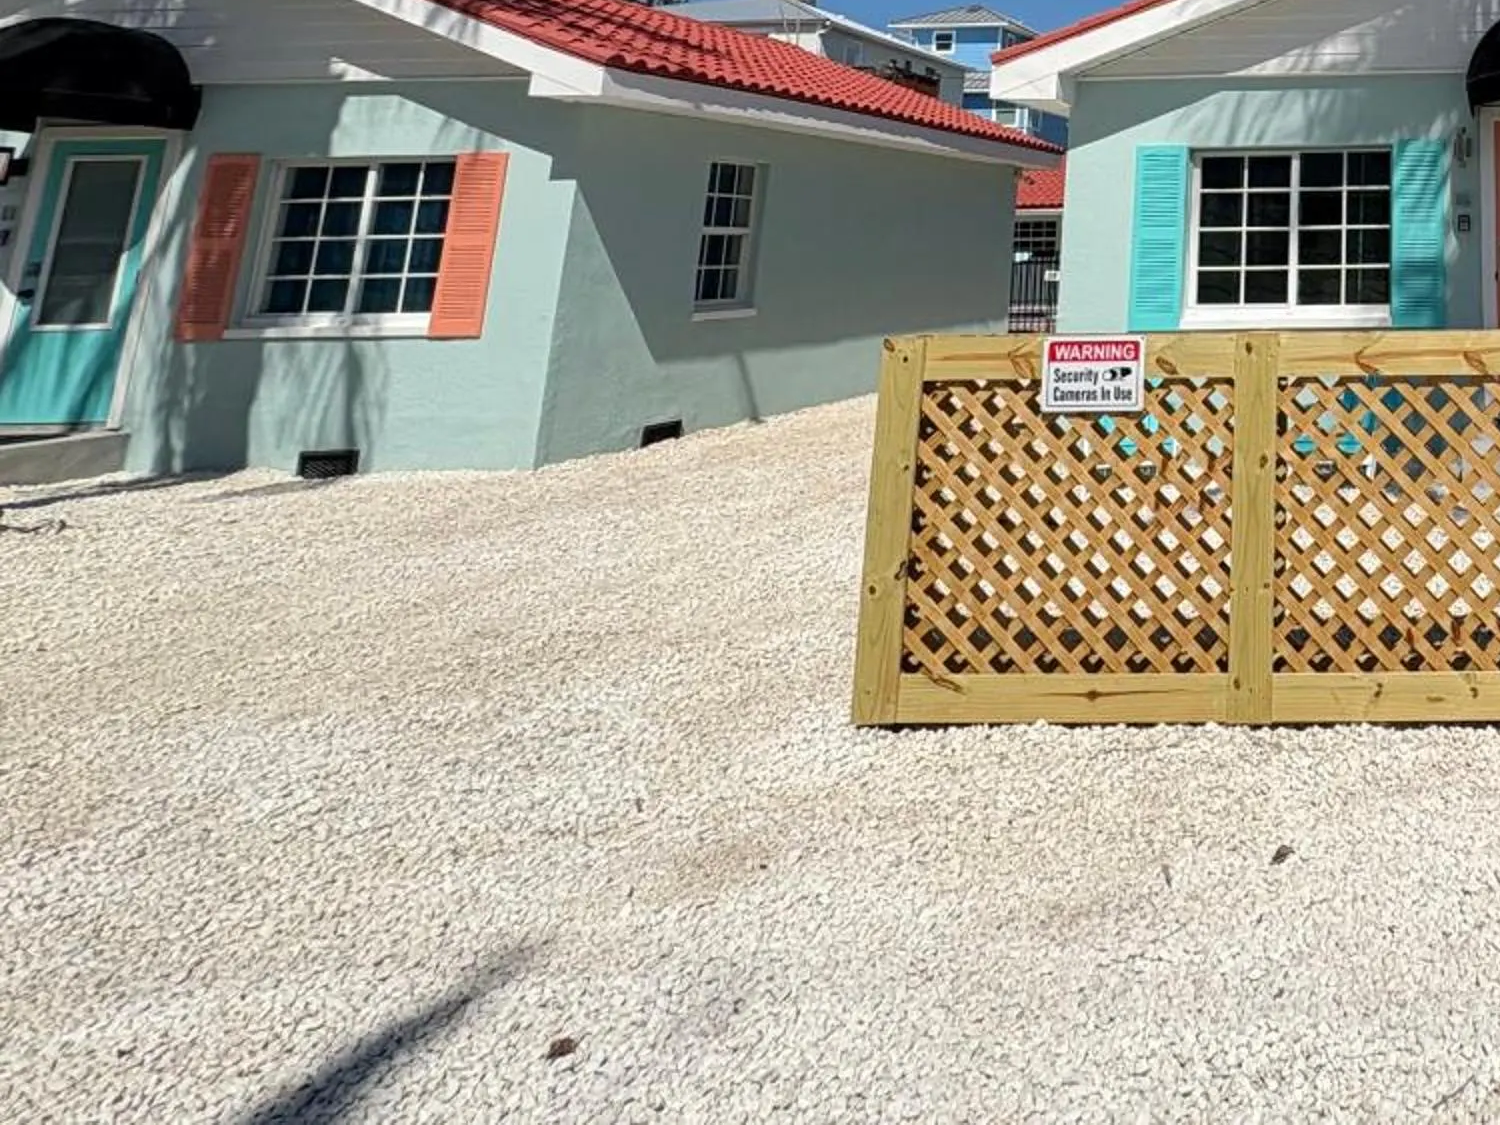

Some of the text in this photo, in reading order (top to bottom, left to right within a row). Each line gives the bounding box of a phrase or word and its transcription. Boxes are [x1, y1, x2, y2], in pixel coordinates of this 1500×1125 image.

[1054, 343, 1136, 361] WARNING
[1053, 367, 1099, 386] Security
[1053, 386, 1132, 402] Cameras In Use
